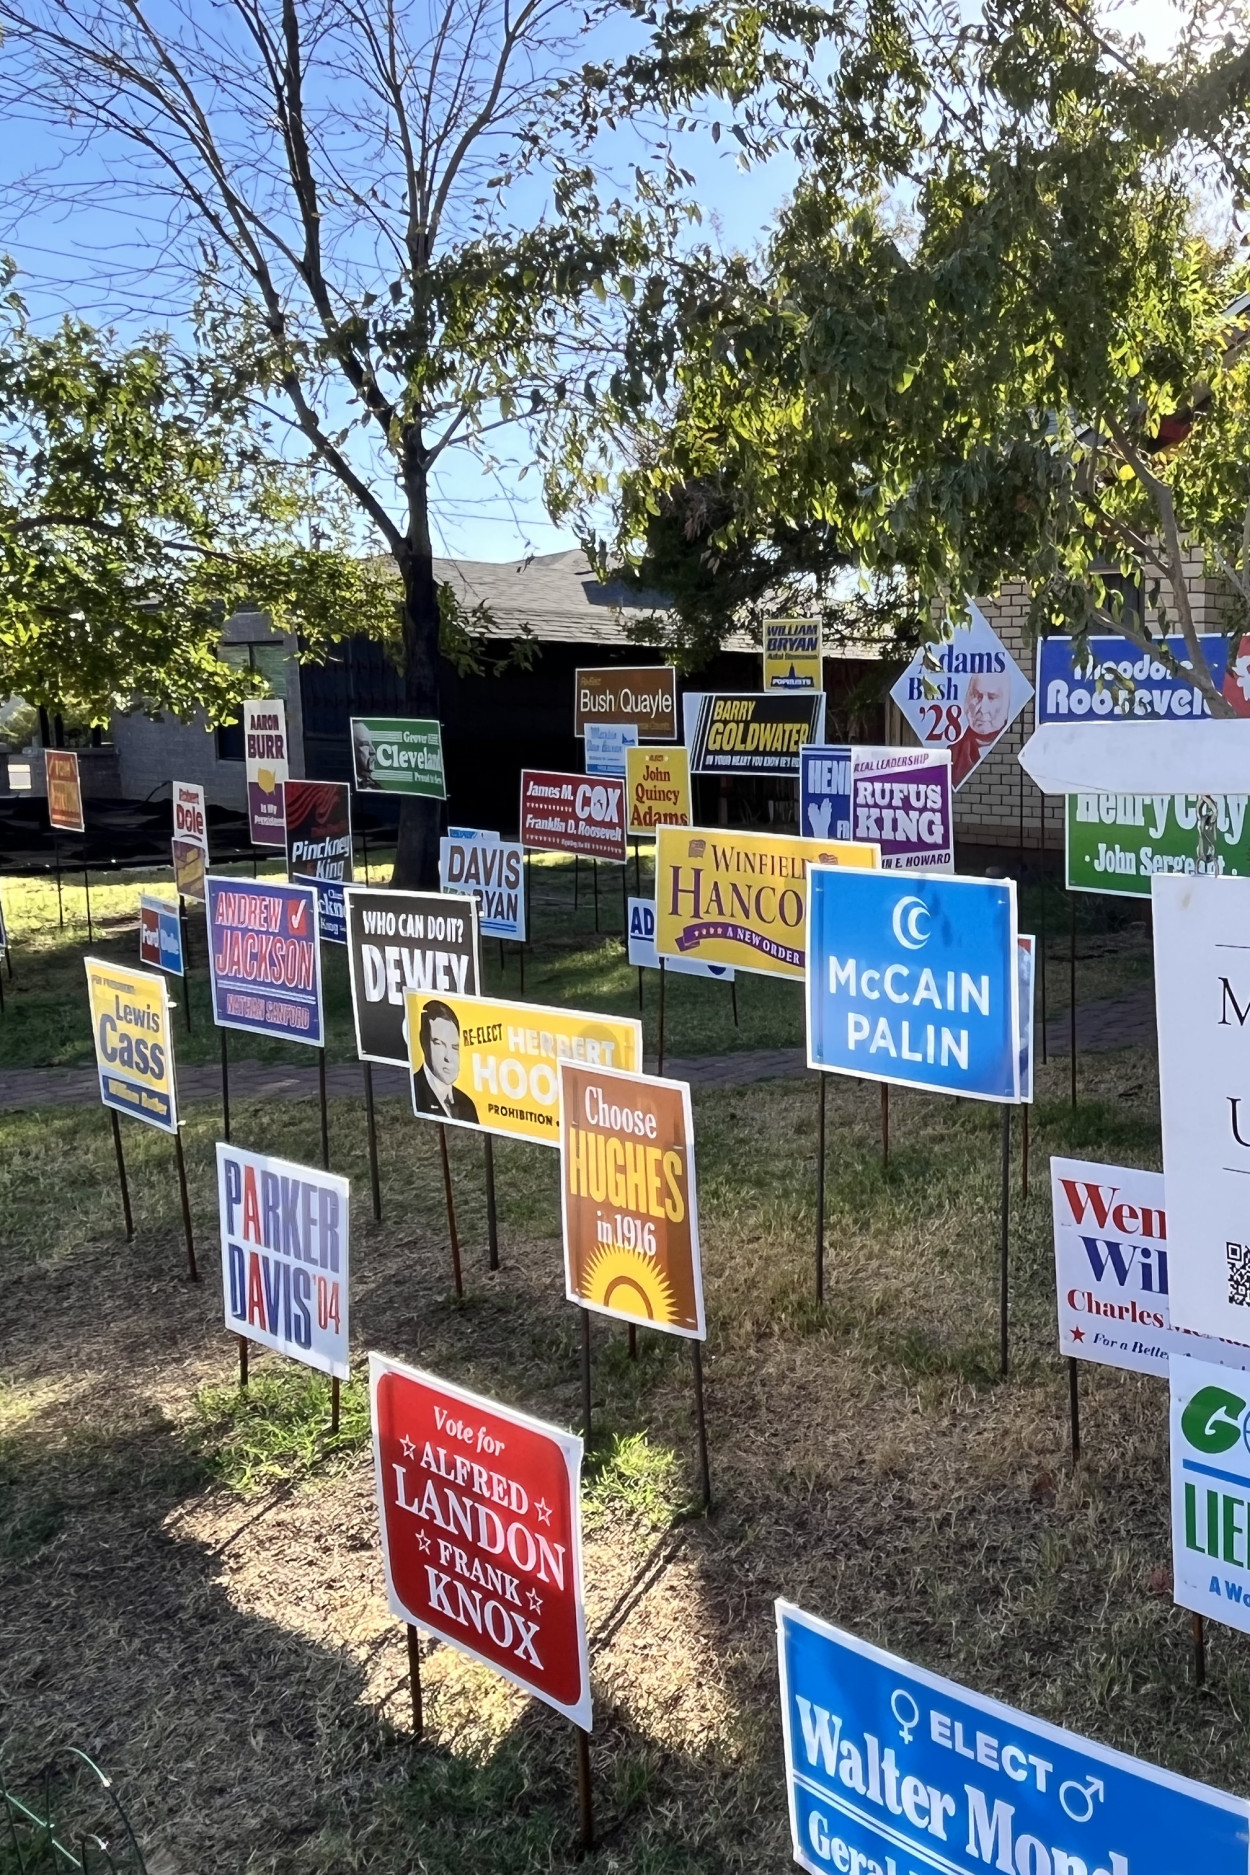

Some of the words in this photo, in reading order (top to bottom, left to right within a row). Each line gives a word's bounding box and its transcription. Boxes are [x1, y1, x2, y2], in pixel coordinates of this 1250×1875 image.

[767, 624, 818, 636] WILLIAM
[767, 637, 818, 652] BRYAN
[250, 713, 280, 731] AARON
[713, 700, 756, 721] BARRY
[247, 734, 286, 760] BURR
[707, 722, 810, 753] GOLDWATER
[642, 765, 671, 782] John
[854, 759, 875, 774] REAL
[876, 753, 930, 771] LEADERSHIP
[526, 780, 561, 800] James
[561, 784, 574, 801] M.
[575, 784, 621, 824] COX
[630, 804, 689, 828] Adams
[635, 783, 680, 806] Quincy
[856, 781, 943, 811] RUFUS
[176, 803, 204, 835] Dole
[525, 813, 566, 834] Franklin
[567, 819, 577, 834] D.
[578, 820, 623, 842] Roosevelt
[855, 807, 944, 846] KING
[316, 859, 345, 880] King
[447, 845, 520, 890] DAVIS
[895, 857, 903, 869] E.
[905, 852, 951, 868] HOWARD
[1094, 842, 1137, 875] John
[214, 891, 283, 934] ANDREW
[669, 864, 807, 928] HANCO
[362, 910, 397, 936] WHO
[398, 913, 424, 939] CAN
[428, 915, 446, 942] DO
[446, 917, 464, 943] IT?
[726, 926, 735, 937] A
[736, 927, 762, 947] NEW
[762, 938, 801, 965] ORDER
[214, 929, 314, 991] JACKSON
[361, 943, 470, 1006] DEWEY
[829, 955, 990, 1017] McCAIN
[114, 994, 160, 1034] Lewis
[100, 1013, 165, 1081] Cass
[462, 1023, 503, 1047] RE-ELECT
[506, 1025, 616, 1067] HERBERT
[847, 1012, 969, 1071] PALIN
[471, 1052, 559, 1107] HOO
[488, 1103, 553, 1127] PROHIBITION
[584, 1085, 658, 1140] Choose
[569, 1127, 685, 1223] HUGHES
[224, 1158, 340, 1274] PARKER
[1058, 1177, 1167, 1241] Wen
[597, 1210, 612, 1246] in
[614, 1213, 657, 1256] 1916
[1078, 1234, 1169, 1296] Wil
[227, 1241, 313, 1351] DAVIS
[1067, 1288, 1165, 1330] Charles
[1093, 1332, 1118, 1348] For
[1119, 1340, 1129, 1351] a
[432, 1405, 474, 1446] Vote
[476, 1426, 506, 1457] for
[420, 1441, 529, 1516] ALFRED
[391, 1463, 567, 1592] LANDON
[436, 1538, 524, 1608] FRANK
[1208, 1575, 1222, 1597] A
[423, 1563, 545, 1671] KNOX
[795, 1694, 957, 1841] Walter
[930, 1711, 1053, 1794] ELECT
